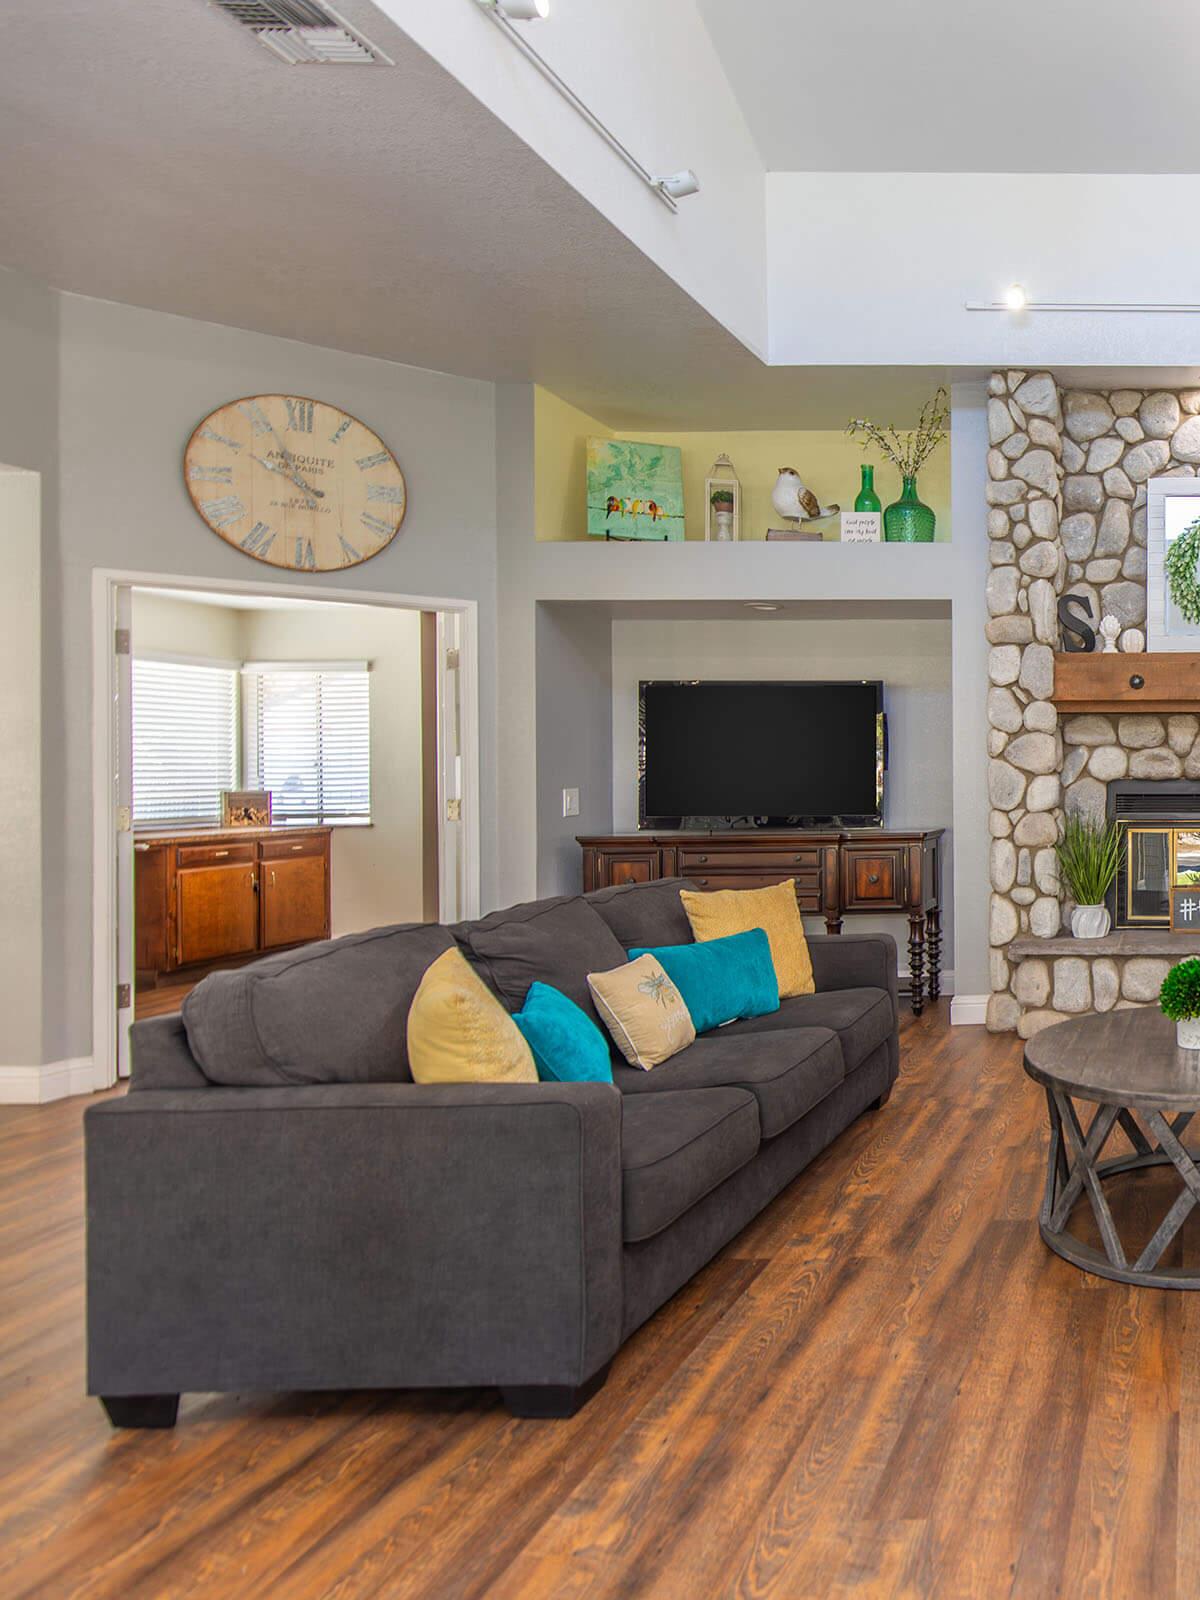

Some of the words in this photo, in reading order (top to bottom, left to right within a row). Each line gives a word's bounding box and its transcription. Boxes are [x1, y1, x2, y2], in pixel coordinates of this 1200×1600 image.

[285, 399, 314, 434] XII
[266, 450, 335, 470] ANIQUITE
[1057, 594, 1096, 653] S
